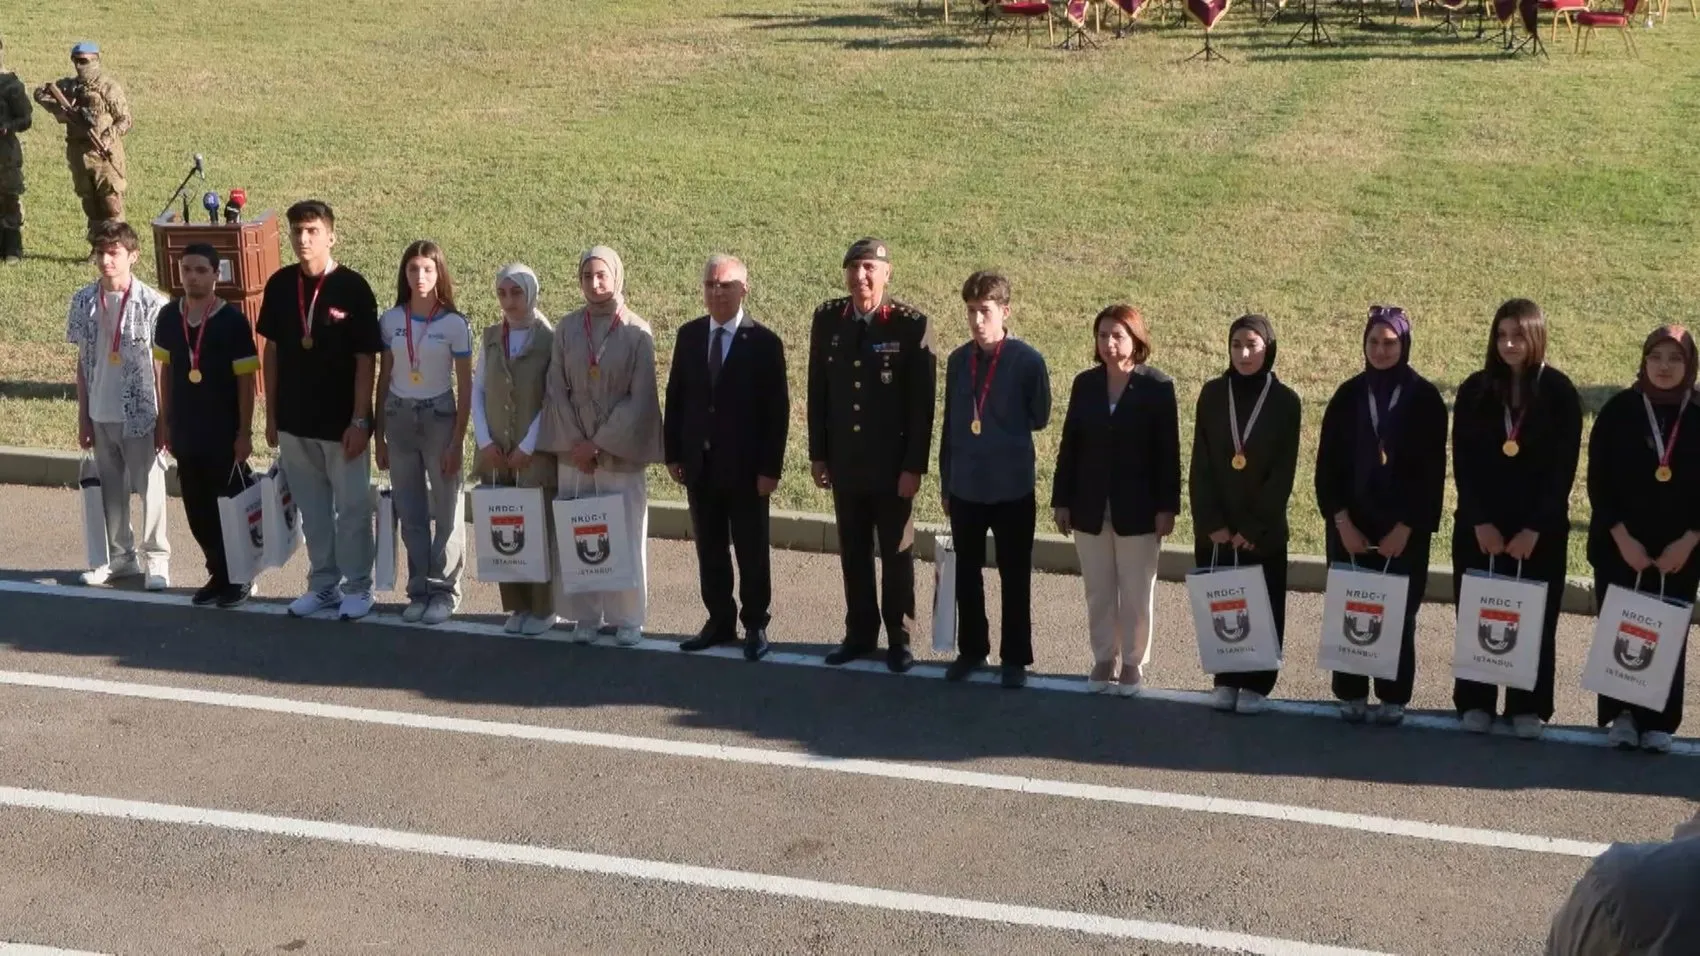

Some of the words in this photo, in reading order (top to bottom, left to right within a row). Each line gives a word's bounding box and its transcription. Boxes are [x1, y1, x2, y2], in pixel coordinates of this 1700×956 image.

[1206, 586, 1246, 599] NRDC-T
[1346, 588, 1387, 601] NRDC-T
[1481, 596, 1523, 609] NRDCT
[1621, 608, 1663, 629] NRDC-T
